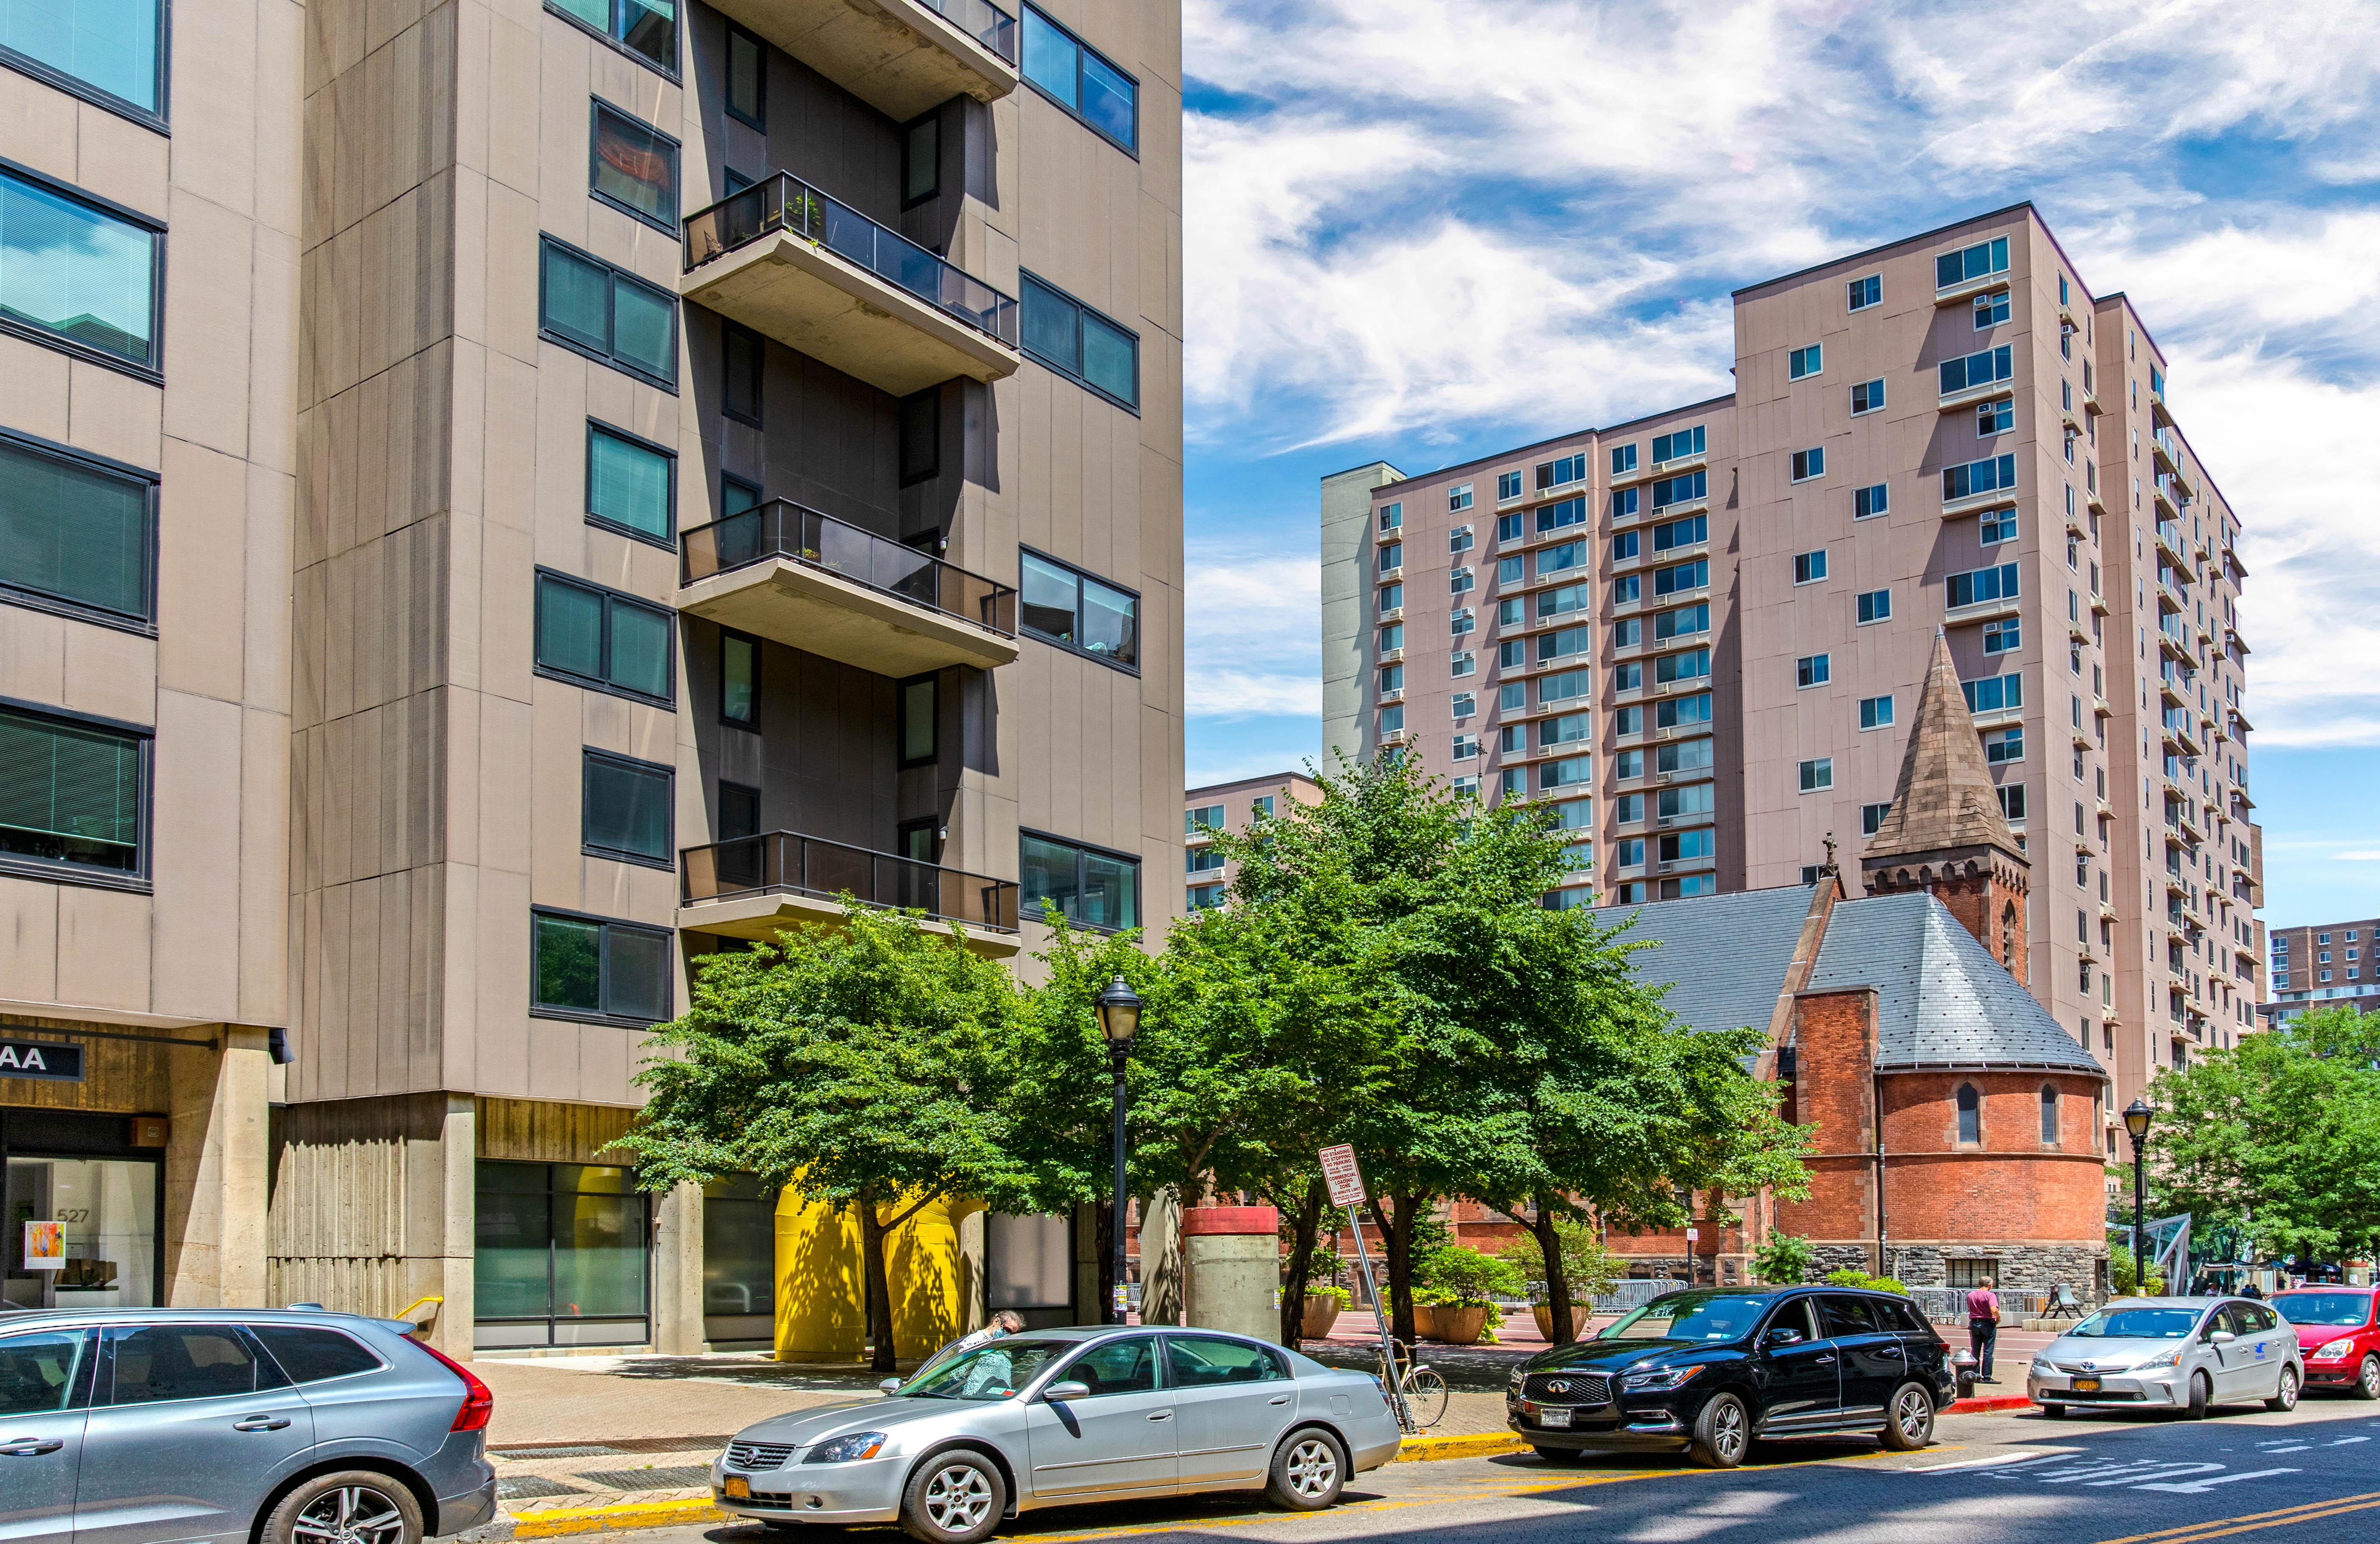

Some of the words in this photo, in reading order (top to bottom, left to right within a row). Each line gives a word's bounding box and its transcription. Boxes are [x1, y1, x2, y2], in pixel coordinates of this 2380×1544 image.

[1329, 1172, 1356, 1181] COMMERCIAL
[58, 1209, 89, 1222] 527
[1544, 1414, 1568, 1423] T530078C
